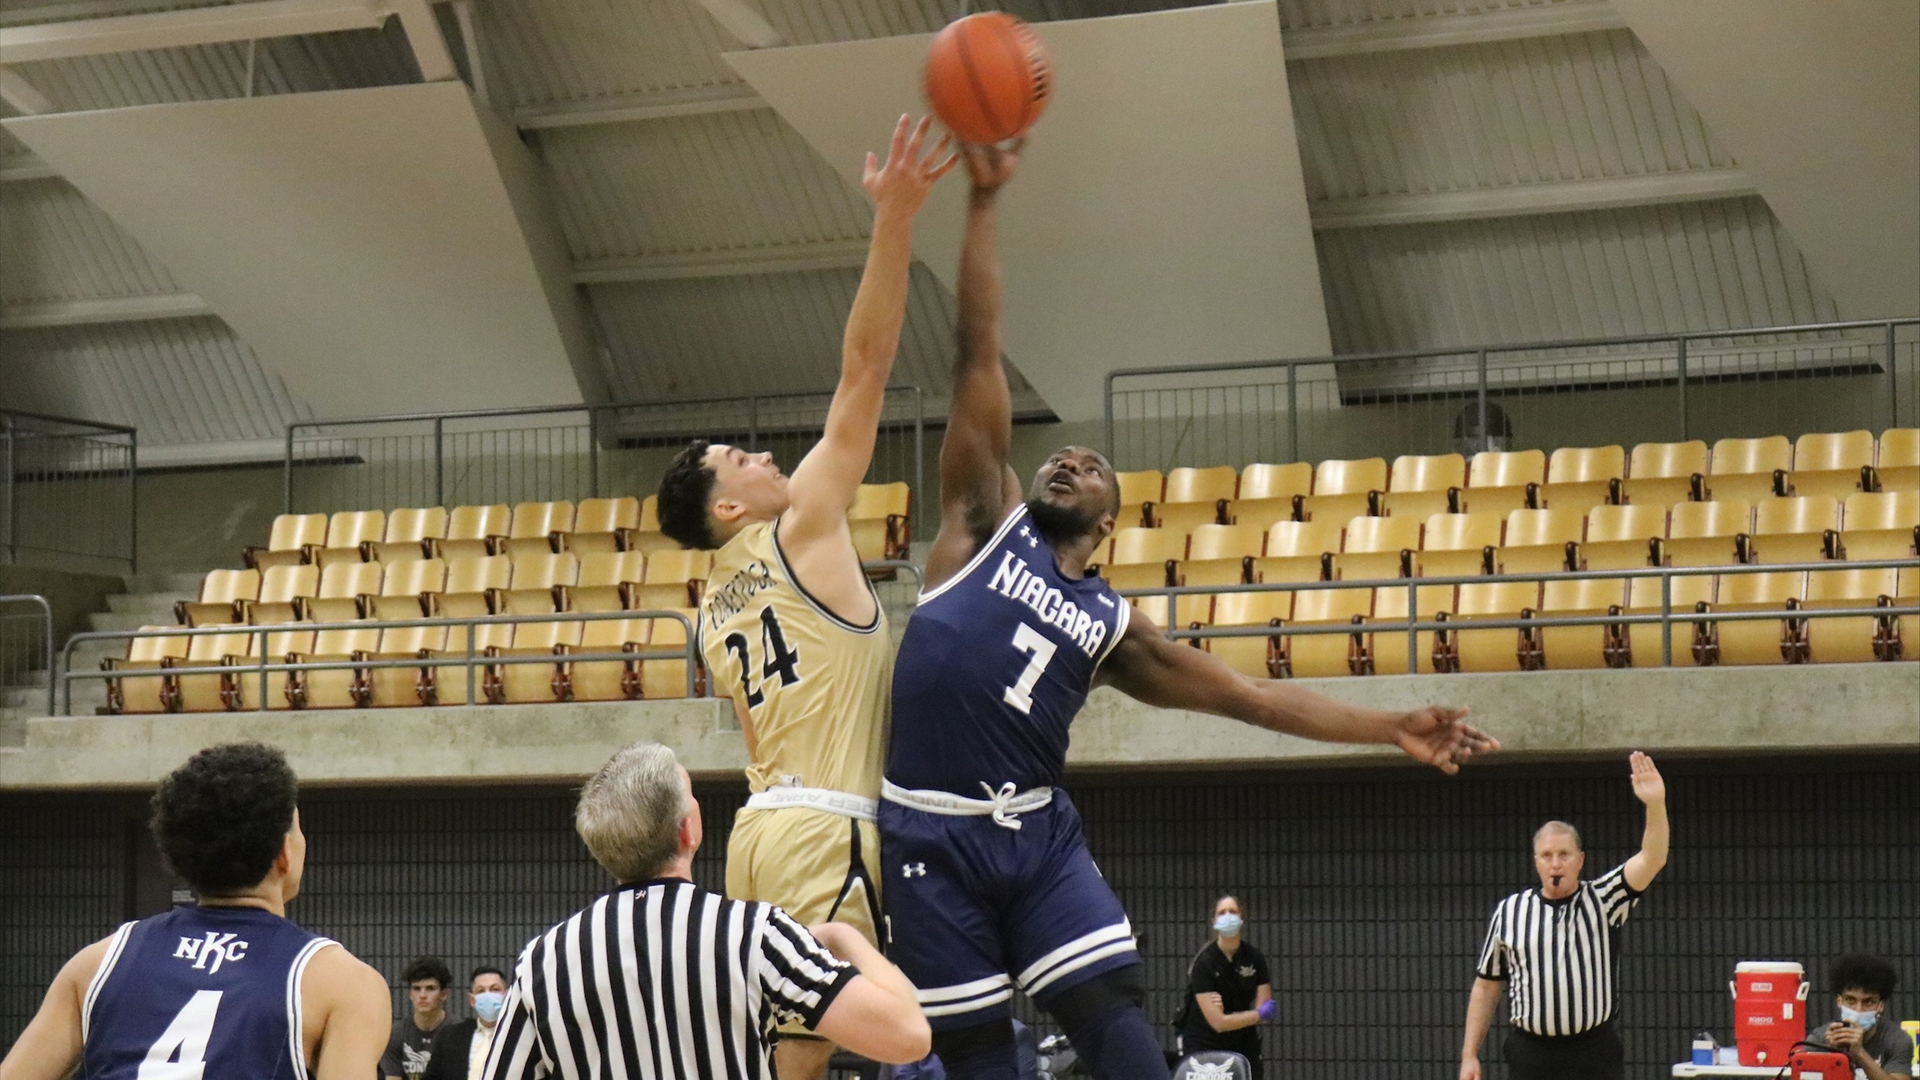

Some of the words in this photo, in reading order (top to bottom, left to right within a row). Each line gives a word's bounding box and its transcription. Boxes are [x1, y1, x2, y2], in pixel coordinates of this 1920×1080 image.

[987, 549, 1107, 658] NIAGARA
[724, 604, 800, 710] 24
[1003, 621, 1058, 715] 7
[172, 931, 249, 975] NKC
[137, 989, 224, 1080] 4
